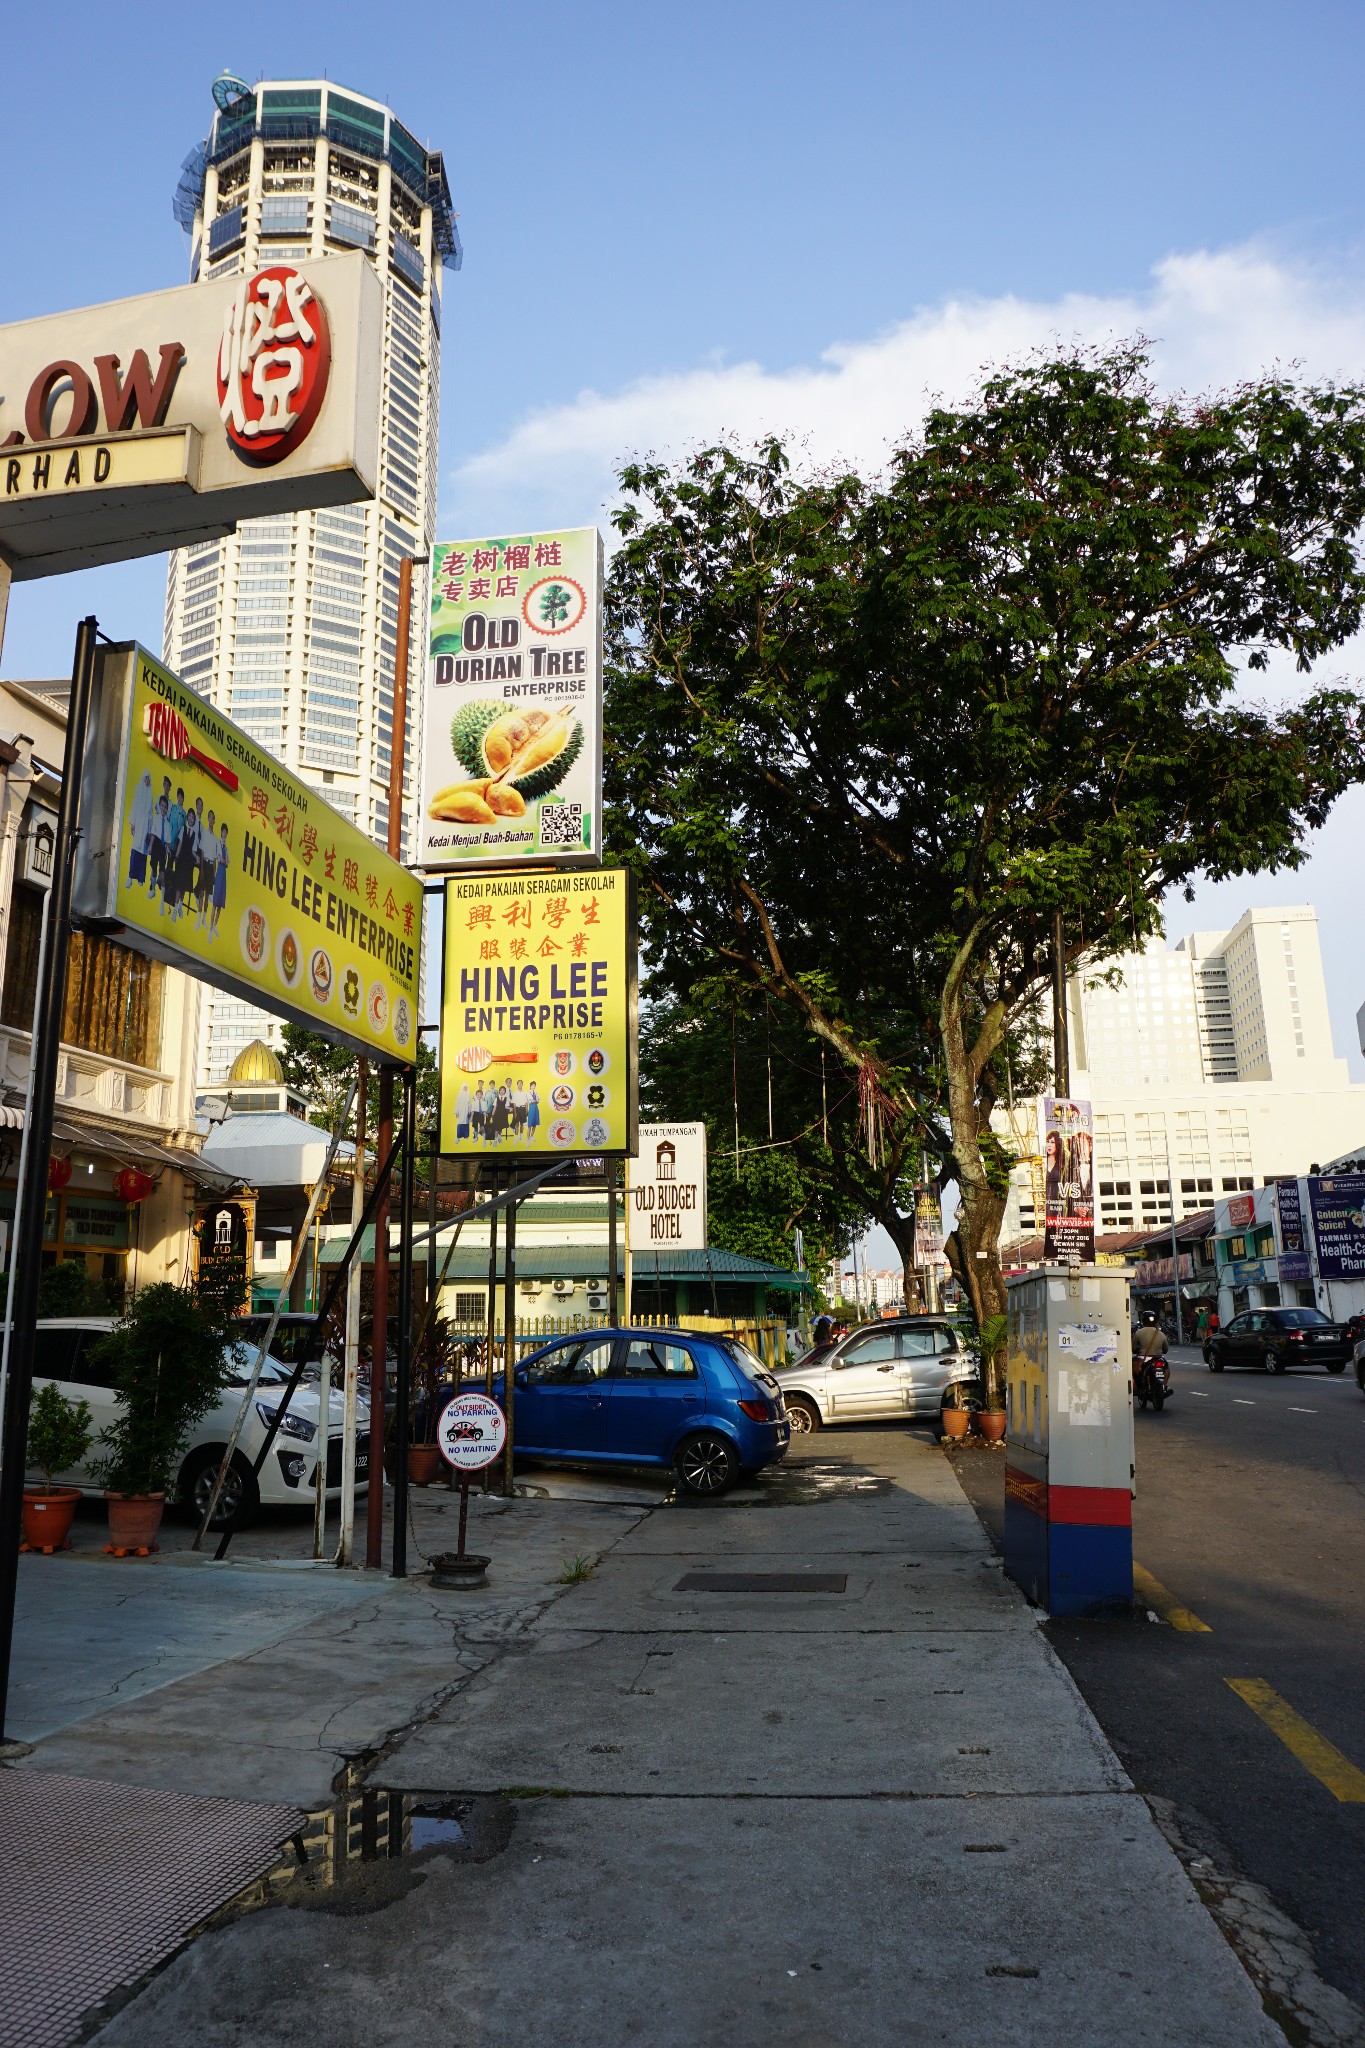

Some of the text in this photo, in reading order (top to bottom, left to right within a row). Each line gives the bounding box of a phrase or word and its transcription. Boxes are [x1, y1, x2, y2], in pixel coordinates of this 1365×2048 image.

[0, 341, 187, 447] OW
[441, 541, 562, 576] 老树榴梿
[441, 576, 519, 602] 专卖店
[463, 613, 519, 652] OLD
[436, 647, 586, 685] DURIAN TREE
[504, 680, 586, 697] ENTERPRISE
[141, 666, 308, 814] KEDAI PAKAIAN SERAGAM SEKOLAH
[145, 702, 190, 760] TENNIS
[428, 830, 534, 848] Kedai Menjual Buah-Buahan
[248, 786, 415, 936] 興利學生服裝企業
[457, 876, 615, 898] KEDAI PAKAIAN SERAGAM SEKOLAH
[242, 831, 413, 981] HING LEE ENTERPRISE
[465, 896, 600, 930] 興利學生
[479, 932, 590, 960] 服裝企業
[461, 961, 608, 1003] HING LEE
[464, 1002, 603, 1033] ENTERPRISE
[639, 1127, 697, 1137] UMAH TUMPANGAN
[635, 1184, 697, 1211] OLD BUDGET
[1057, 1182, 1081, 1199] VS
[650, 1213, 682, 1240] HOTEL
[1047, 1219, 1094, 1227] WWW.VIP.MY
[1317, 1210, 1348, 1219] Golden
[1318, 1221, 1346, 1231] Spice!
[91, 1223, 116, 1237] BUDGET
[1319, 1234, 1351, 1242] FARMASI
[462, 1408, 498, 1416] PARKING
[358, 1456, 368, 1467] 222
[448, 1445, 497, 1454] NO WAITING
